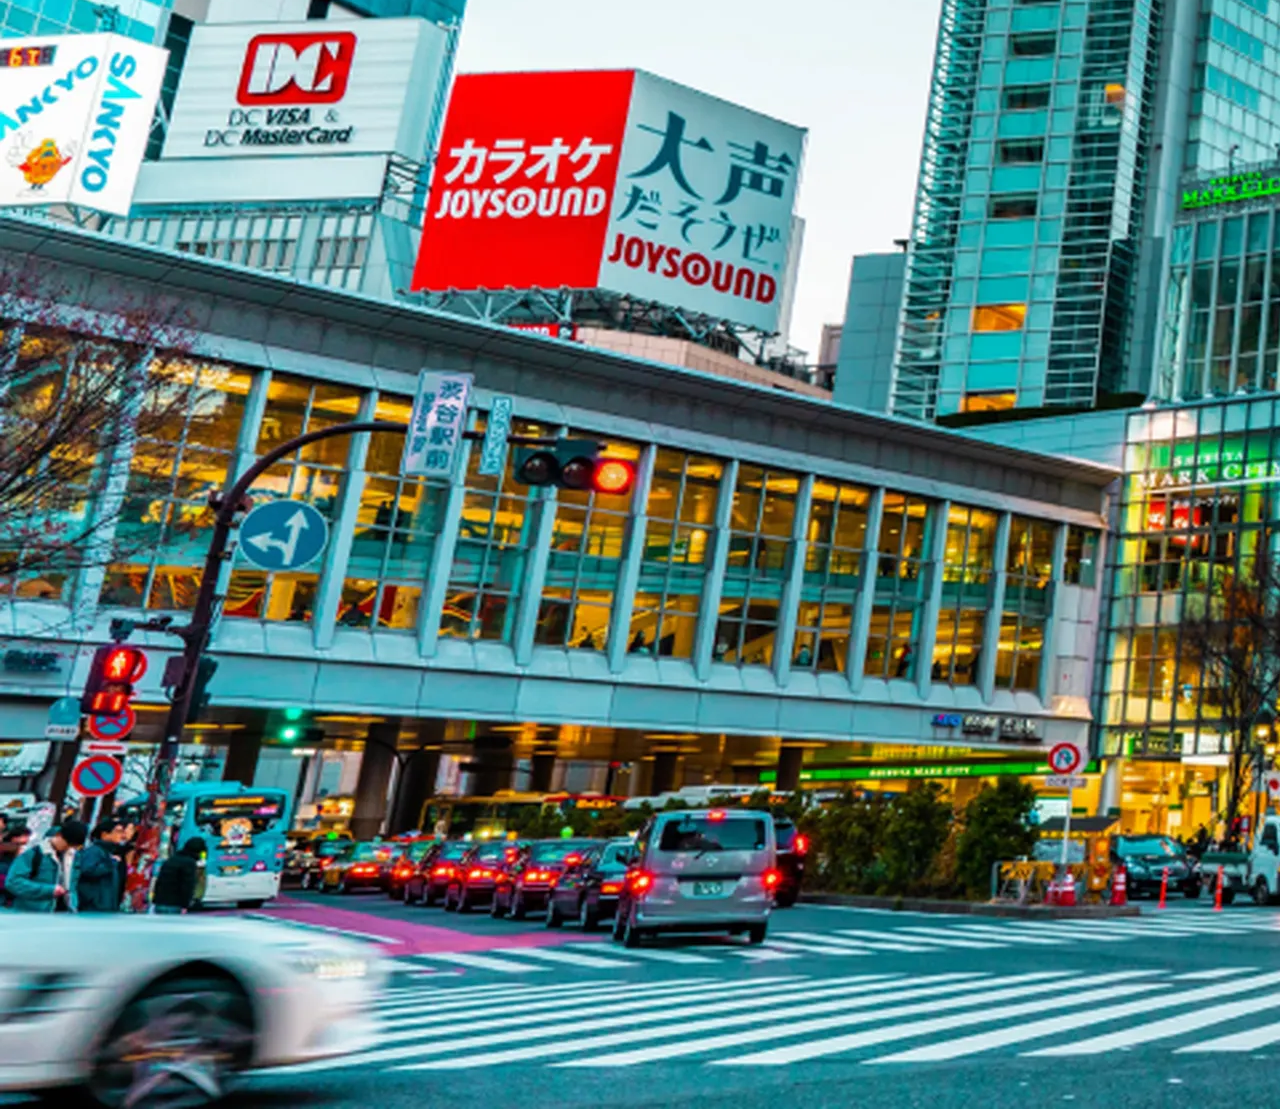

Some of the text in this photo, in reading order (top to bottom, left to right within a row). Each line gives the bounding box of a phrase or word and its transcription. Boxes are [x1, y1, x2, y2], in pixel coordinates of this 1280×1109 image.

[247, 41, 342, 94] DC
[80, 51, 144, 193] SANKYO
[203, 125, 354, 148] DC MasterCard
[228, 108, 262, 127] DC
[264, 107, 312, 126] VISA
[443, 136, 614, 184] カラオケ
[626, 110, 797, 207] 大声
[434, 185, 606, 220] JOYSOUND
[607, 232, 778, 305] JOYSOUND
